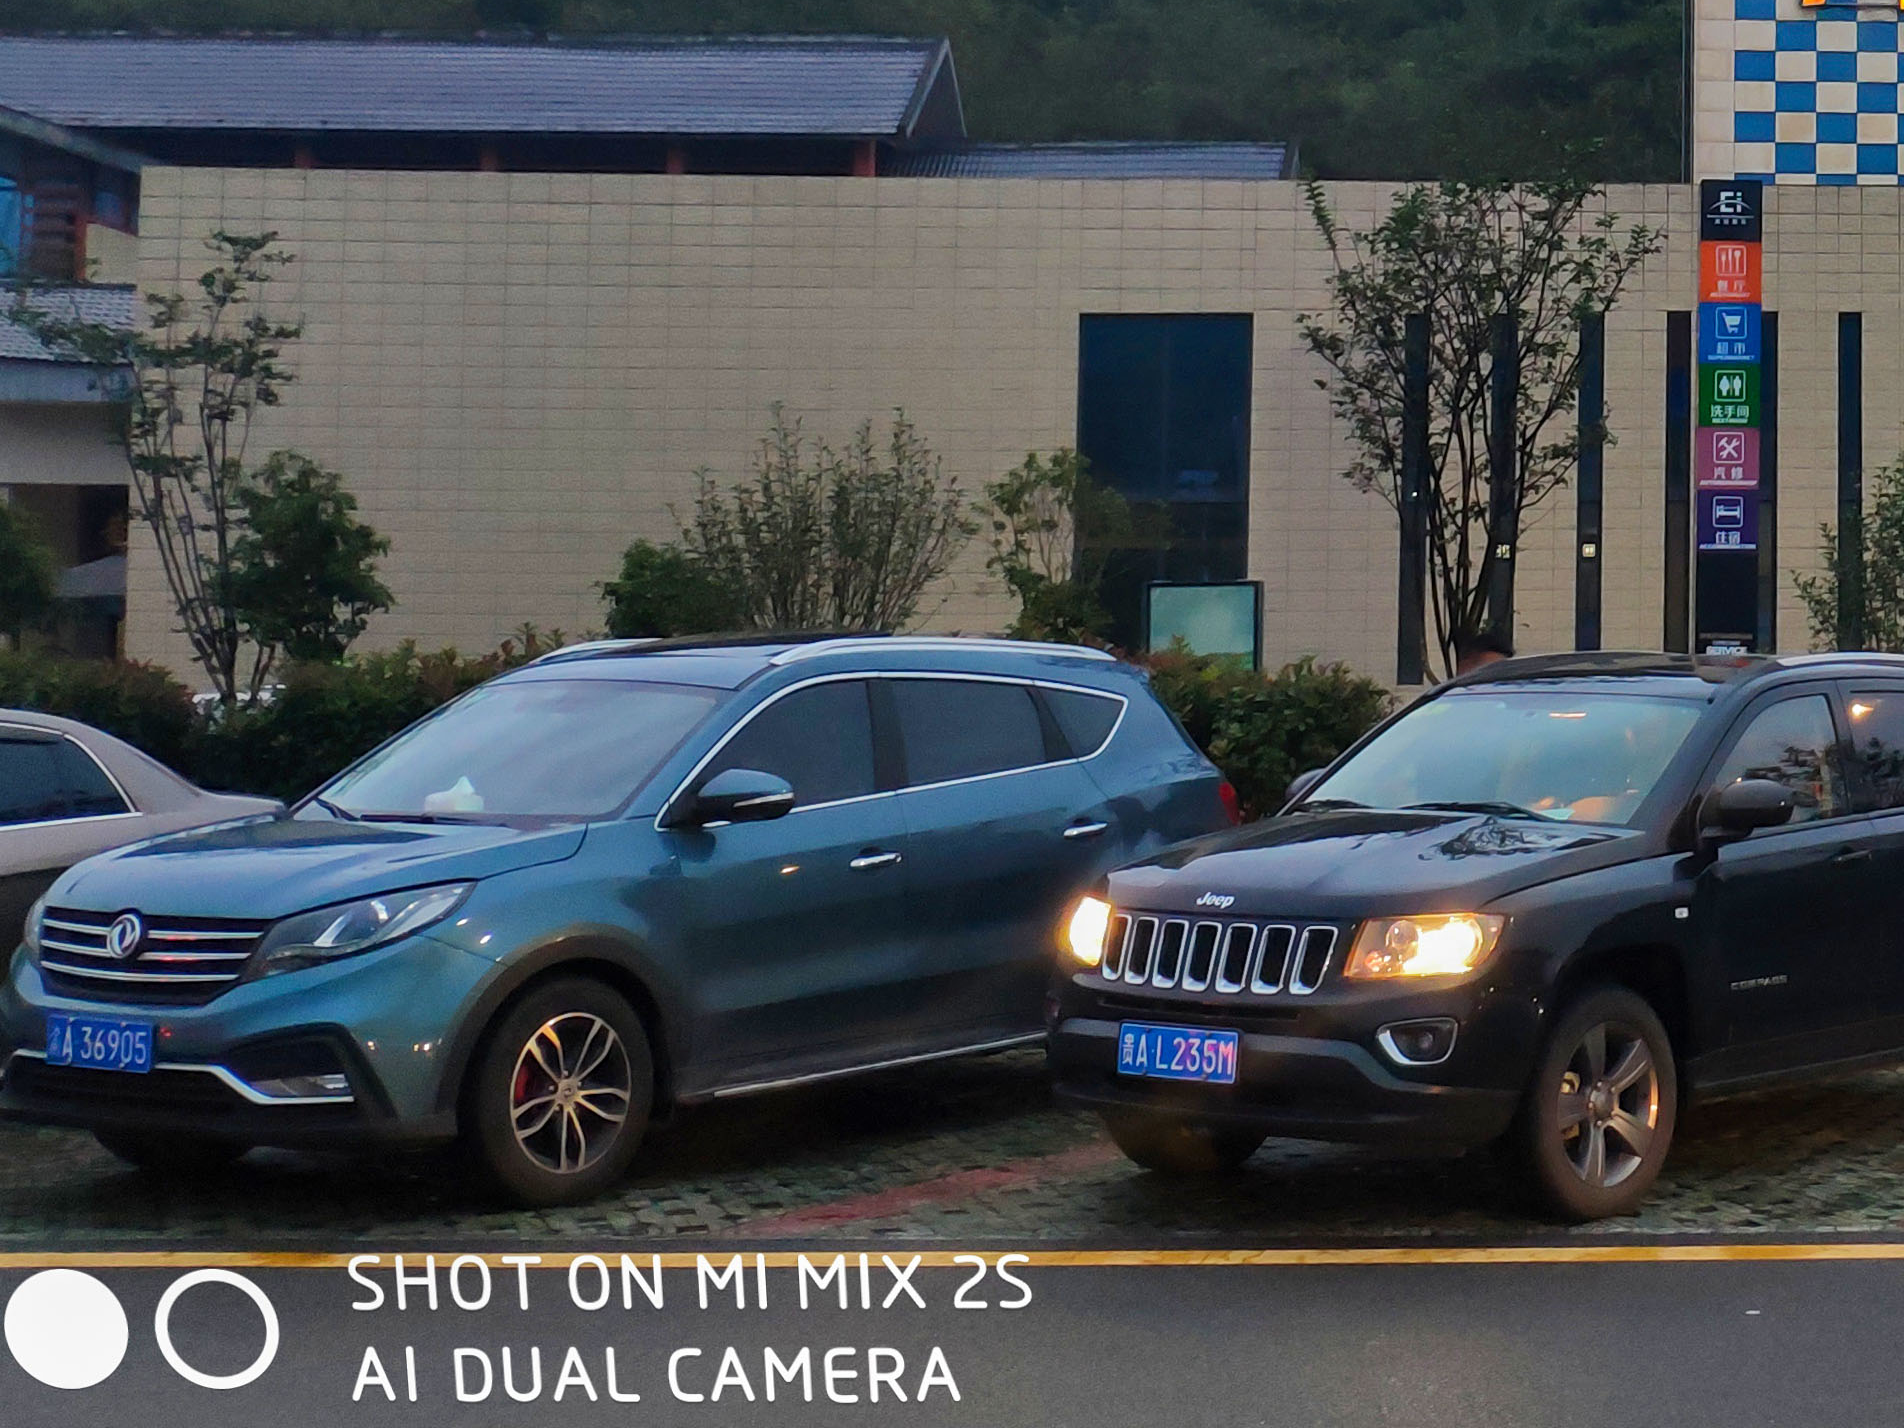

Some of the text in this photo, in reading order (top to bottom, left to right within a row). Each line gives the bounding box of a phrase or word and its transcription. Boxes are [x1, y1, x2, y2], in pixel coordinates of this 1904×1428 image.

[1711, 404, 1749, 418] 洗手间
[1196, 892, 1235, 909] Jeep
[48, 1024, 147, 1065] A36905
